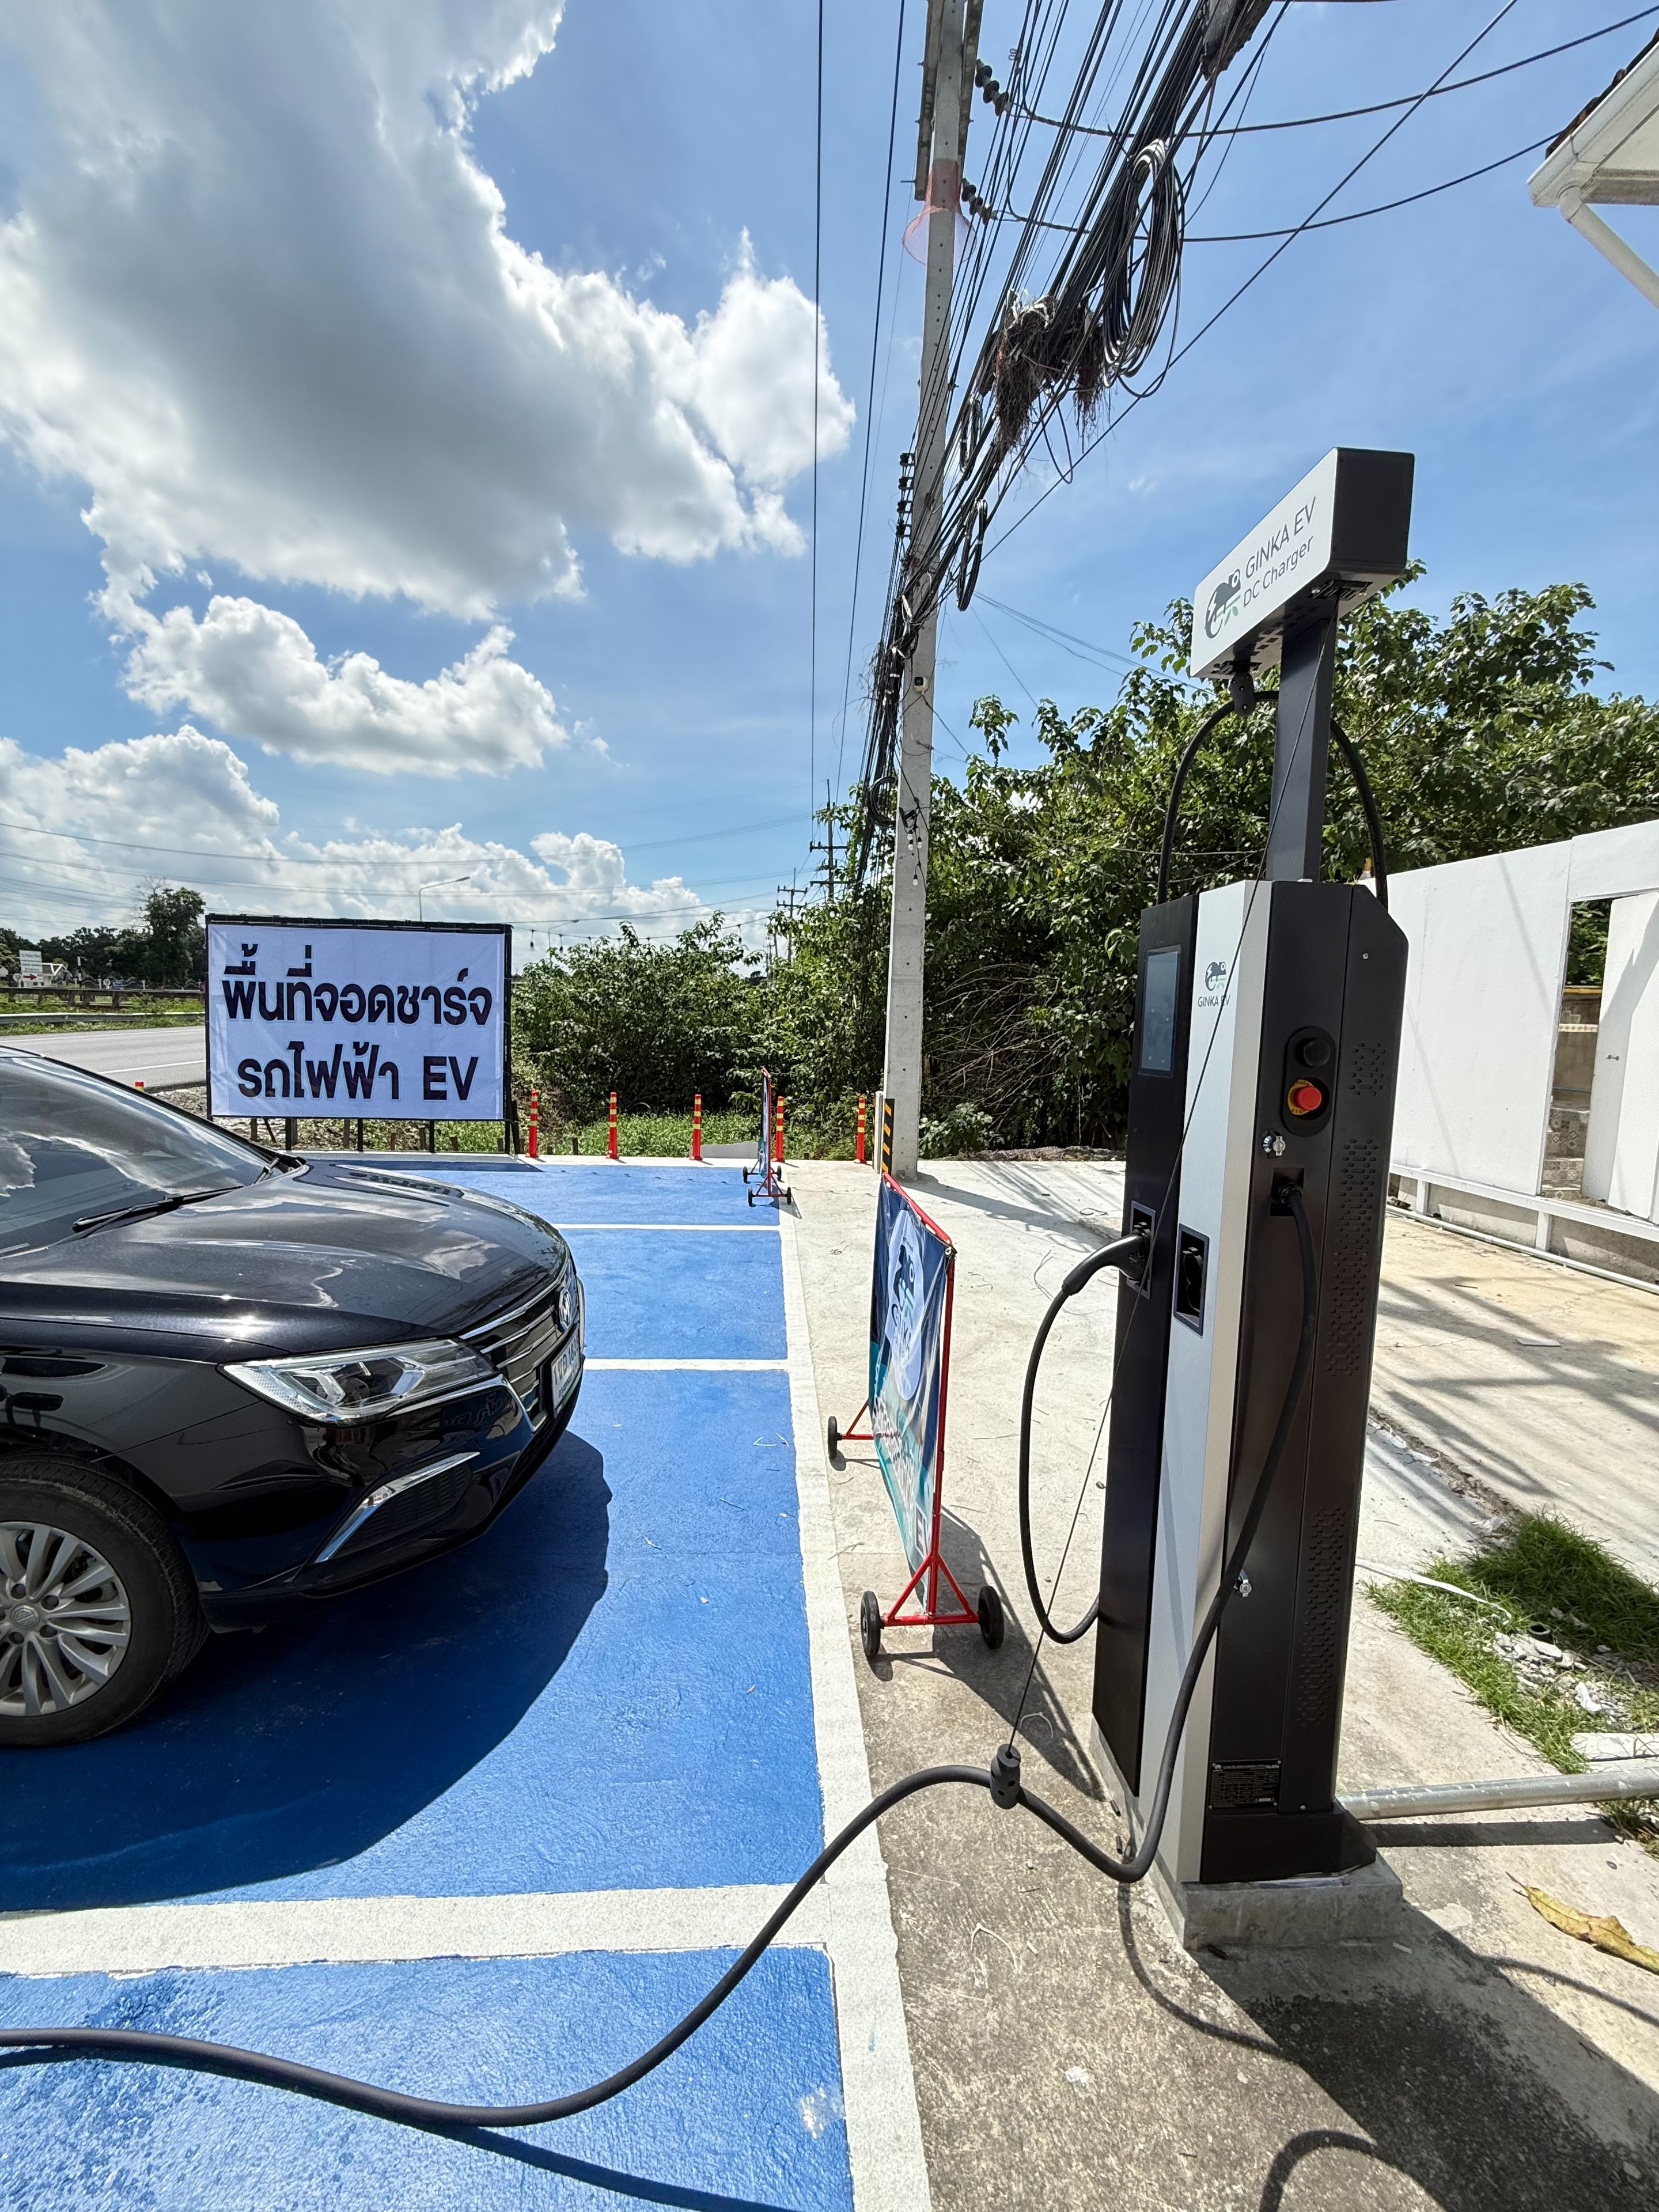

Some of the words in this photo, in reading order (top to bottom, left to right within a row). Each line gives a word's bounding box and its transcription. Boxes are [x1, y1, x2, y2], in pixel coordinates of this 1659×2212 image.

[1243, 579, 1260, 608] DC
[1263, 535, 1314, 590] Charger
[1245, 524, 1290, 579] GINKA
[1294, 495, 1316, 536] EV
[221, 943, 493, 1025] พื้นที่จอดชาร์จ
[1198, 995, 1219, 1007] GINKA
[237, 1040, 400, 1100] รถไฟฟ้า
[423, 1056, 479, 1100] EV
